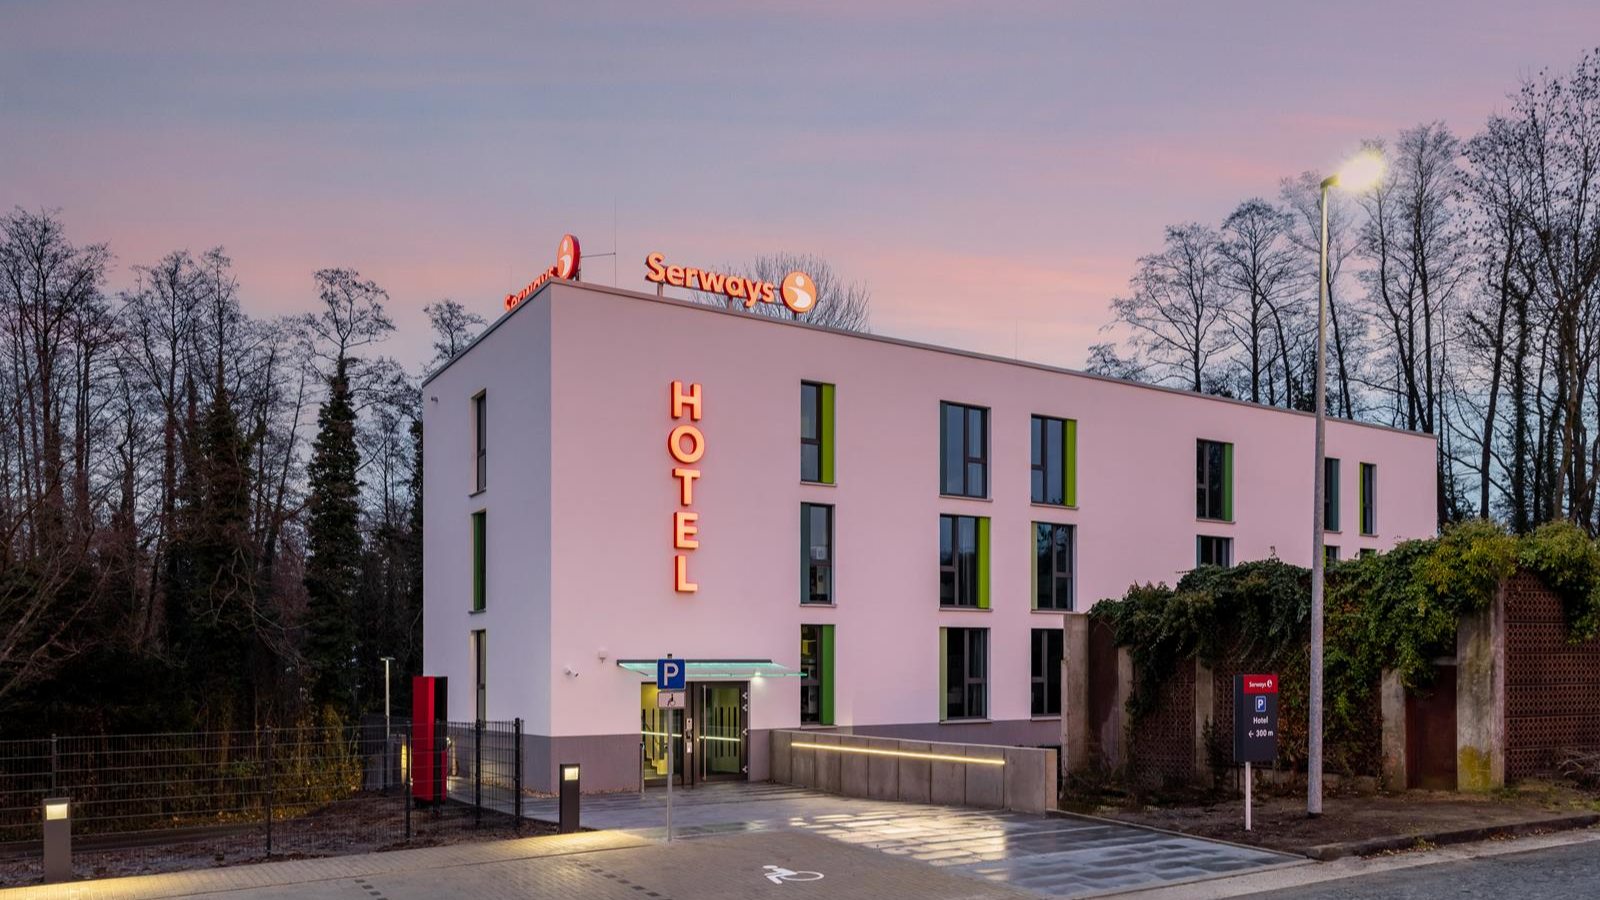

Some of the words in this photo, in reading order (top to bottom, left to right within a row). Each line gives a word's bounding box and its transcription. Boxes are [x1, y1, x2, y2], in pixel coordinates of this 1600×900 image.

[645, 251, 775, 308] Serways
[668, 381, 705, 592] HOTEL
[664, 663, 679, 686] P
[1249, 681, 1266, 689] Serways
[1253, 716, 1269, 725] Hotel
[1256, 729, 1267, 737] 300
